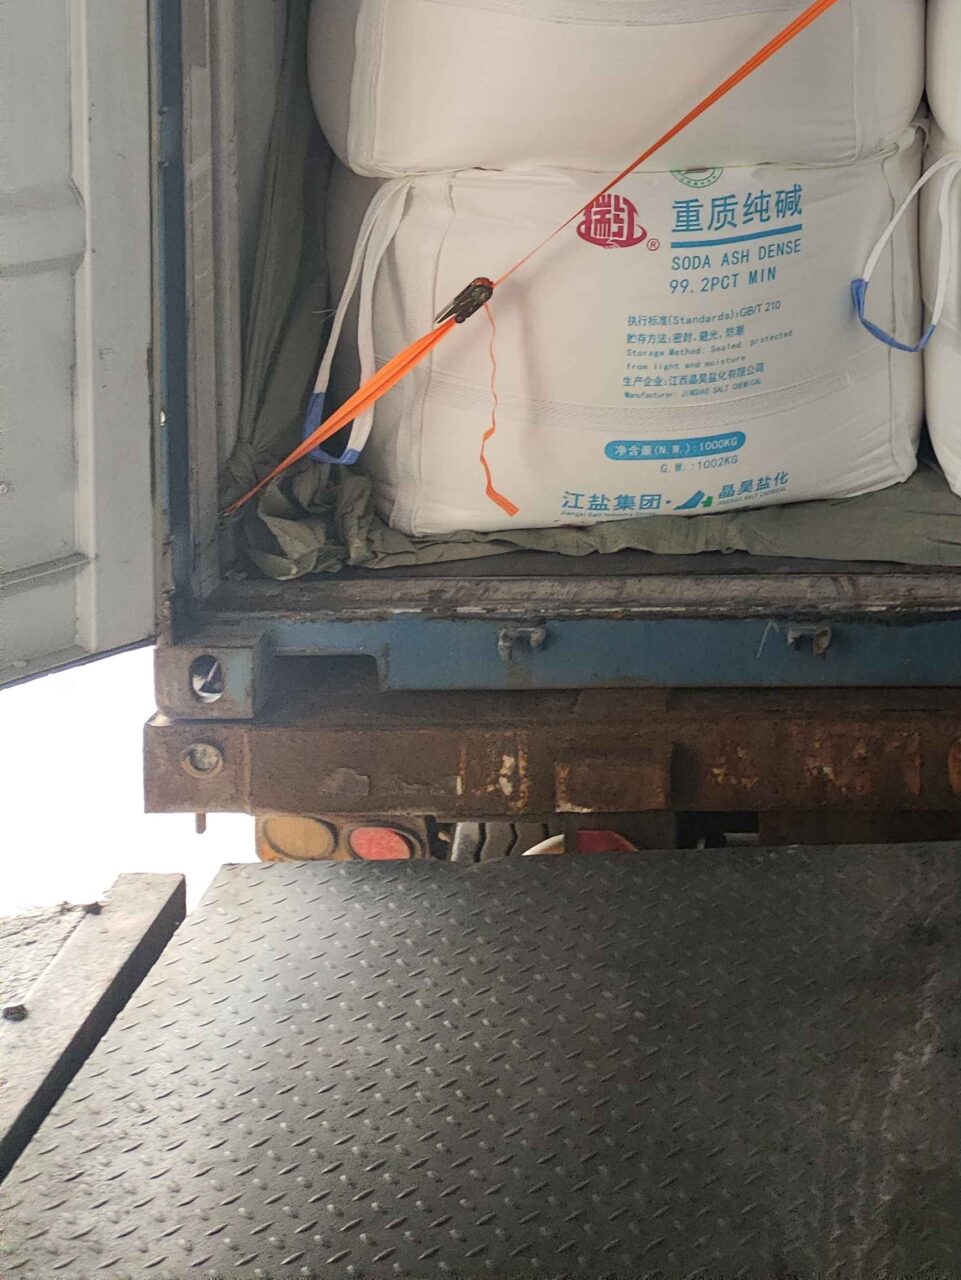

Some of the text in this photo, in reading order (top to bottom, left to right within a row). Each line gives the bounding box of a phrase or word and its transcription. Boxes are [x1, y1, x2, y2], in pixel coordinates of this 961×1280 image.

[671, 183, 803, 234] 重质纯碱
[671, 238, 801, 271] SODA ASH DENSE
[669, 266, 777, 294] 99.2PCT MIN
